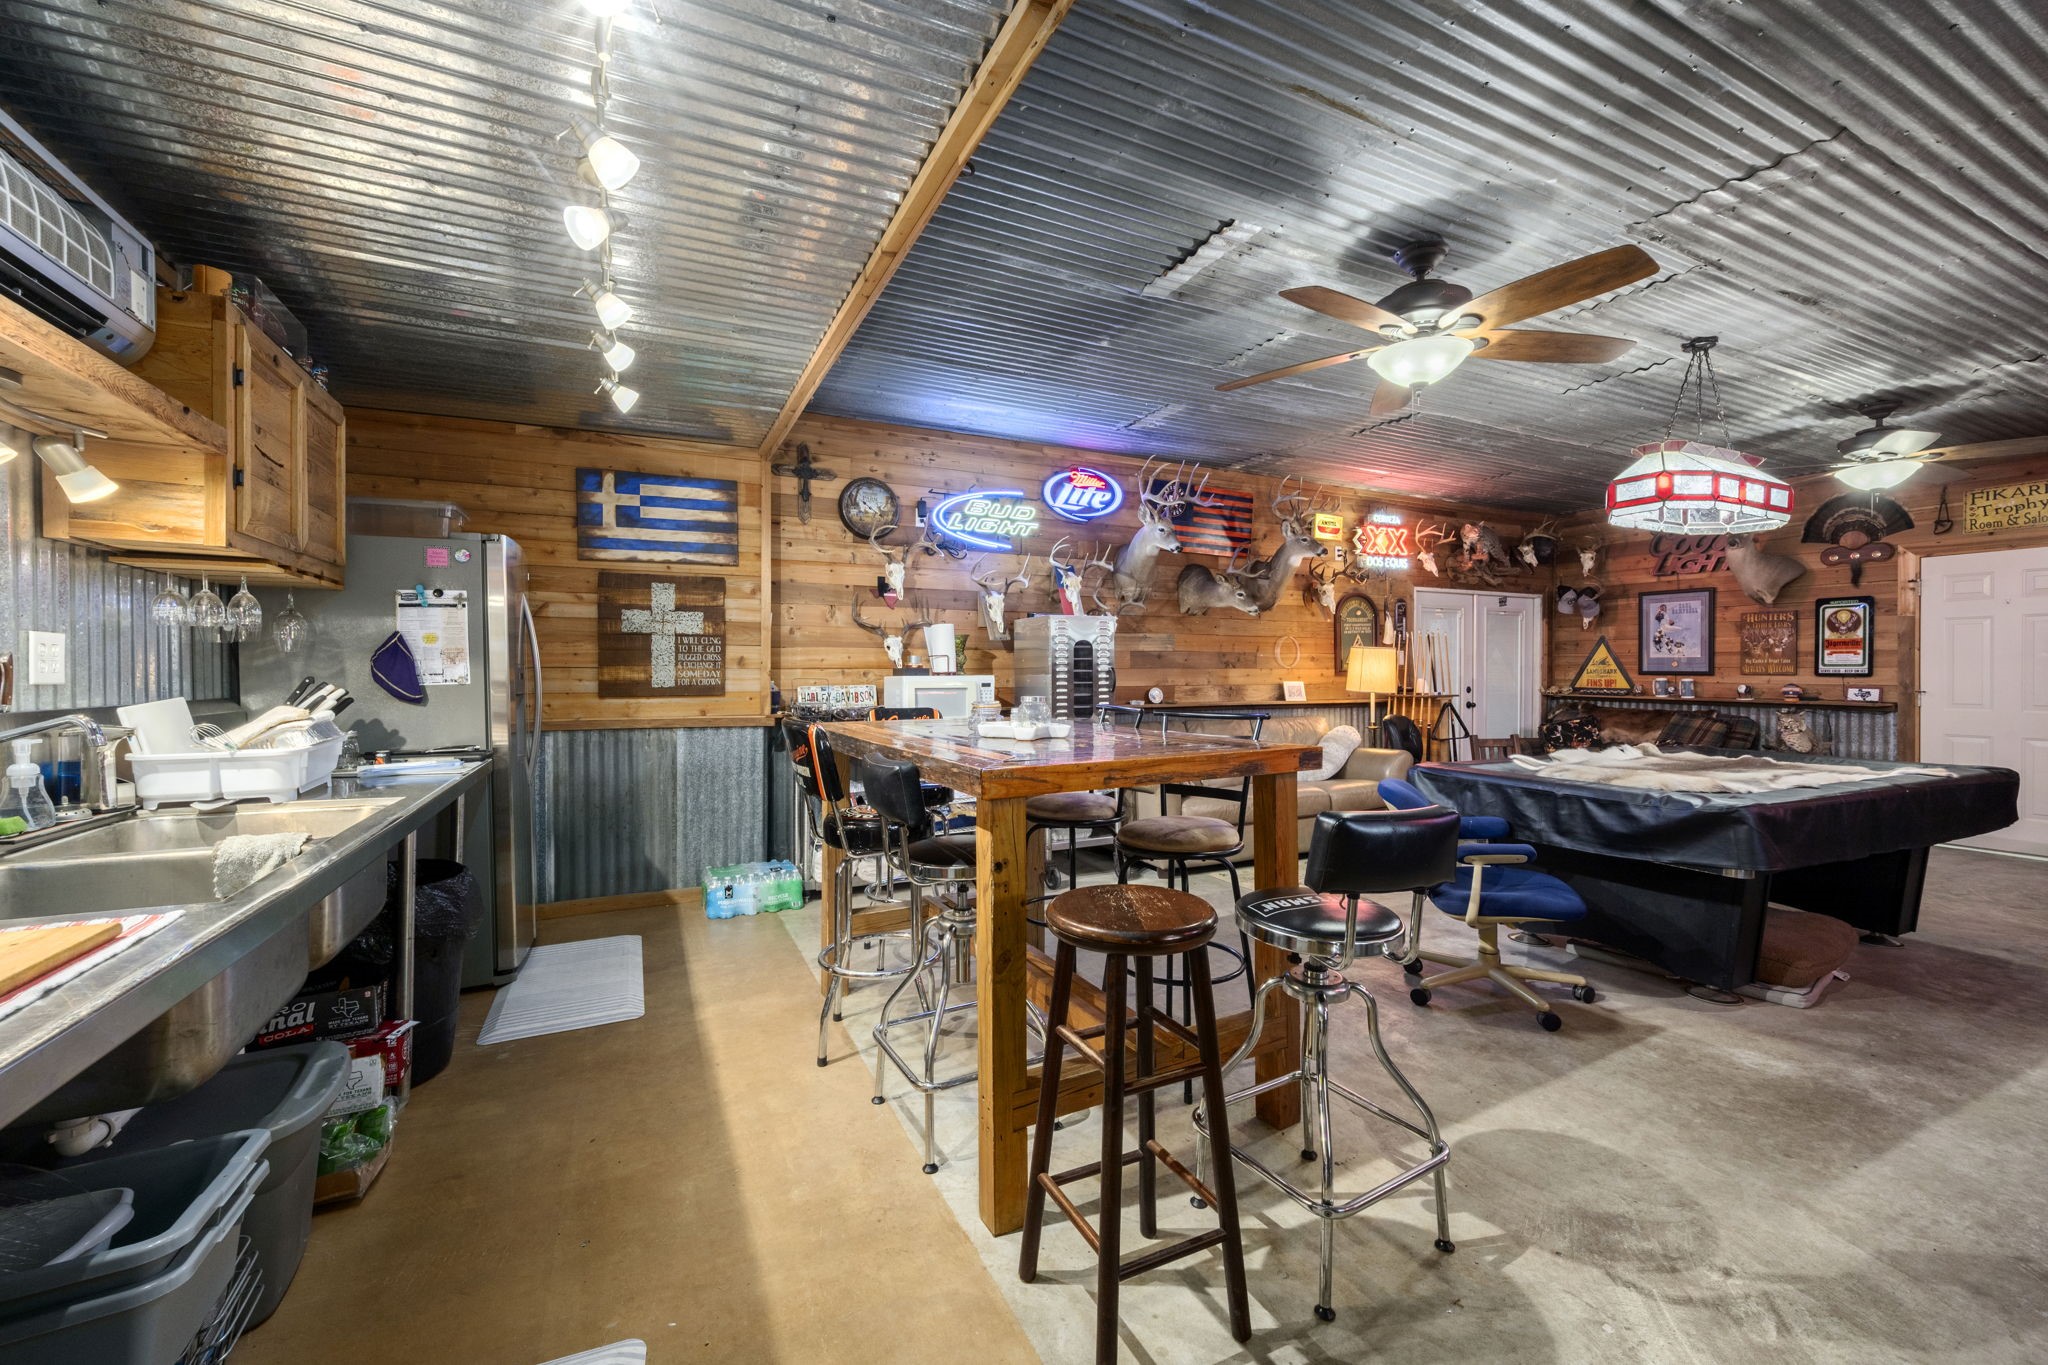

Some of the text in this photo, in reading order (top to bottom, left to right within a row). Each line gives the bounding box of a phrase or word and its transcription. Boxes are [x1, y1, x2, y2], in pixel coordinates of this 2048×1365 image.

[1070, 471, 1106, 488] Miller
[1052, 483, 1112, 510] Lite
[964, 499, 1036, 521] BUD
[1977, 496, 2048, 517] Trophy
[947, 512, 1040, 537] LIGHT
[1969, 518, 2003, 531] Room
[1366, 525, 1408, 556] XX
[1366, 556, 1408, 569] DOS EQUIS
[682, 636, 700, 644] WILL
[700, 636, 722, 645] CLING
[679, 645, 722, 653] TO THE OLD
[678, 653, 722, 661] RUGGED CROSS
[678, 670, 721, 678] SOMEDAY
[677, 678, 690, 686] FOR
[698, 678, 721, 686] CROWN
[1586, 678, 1617, 688] FINS UP!
[1260, 896, 1320, 911] SMAN
[263, 1026, 311, 1043] COLA
